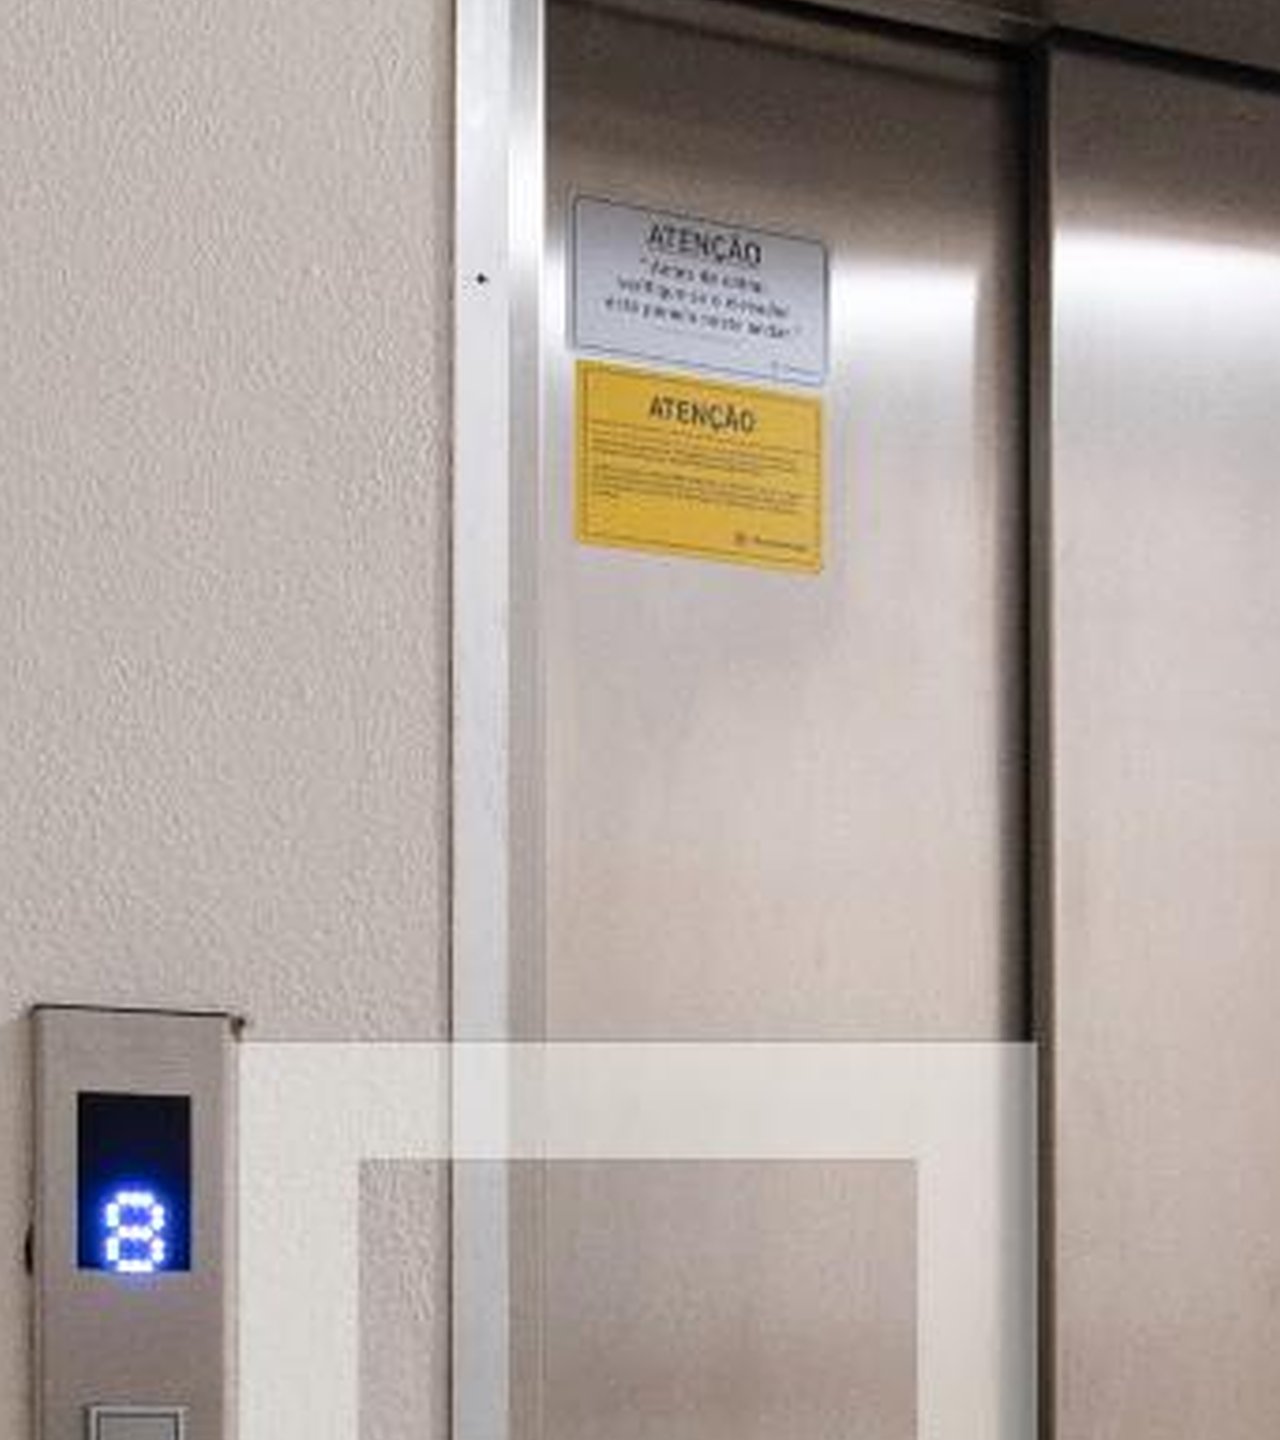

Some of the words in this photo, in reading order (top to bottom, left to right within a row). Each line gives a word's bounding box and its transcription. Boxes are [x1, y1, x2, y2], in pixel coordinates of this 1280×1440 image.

[648, 223, 762, 265] ATENÇÃO
[648, 394, 757, 435] ATENÇÃO
[105, 1190, 166, 1273] 8
